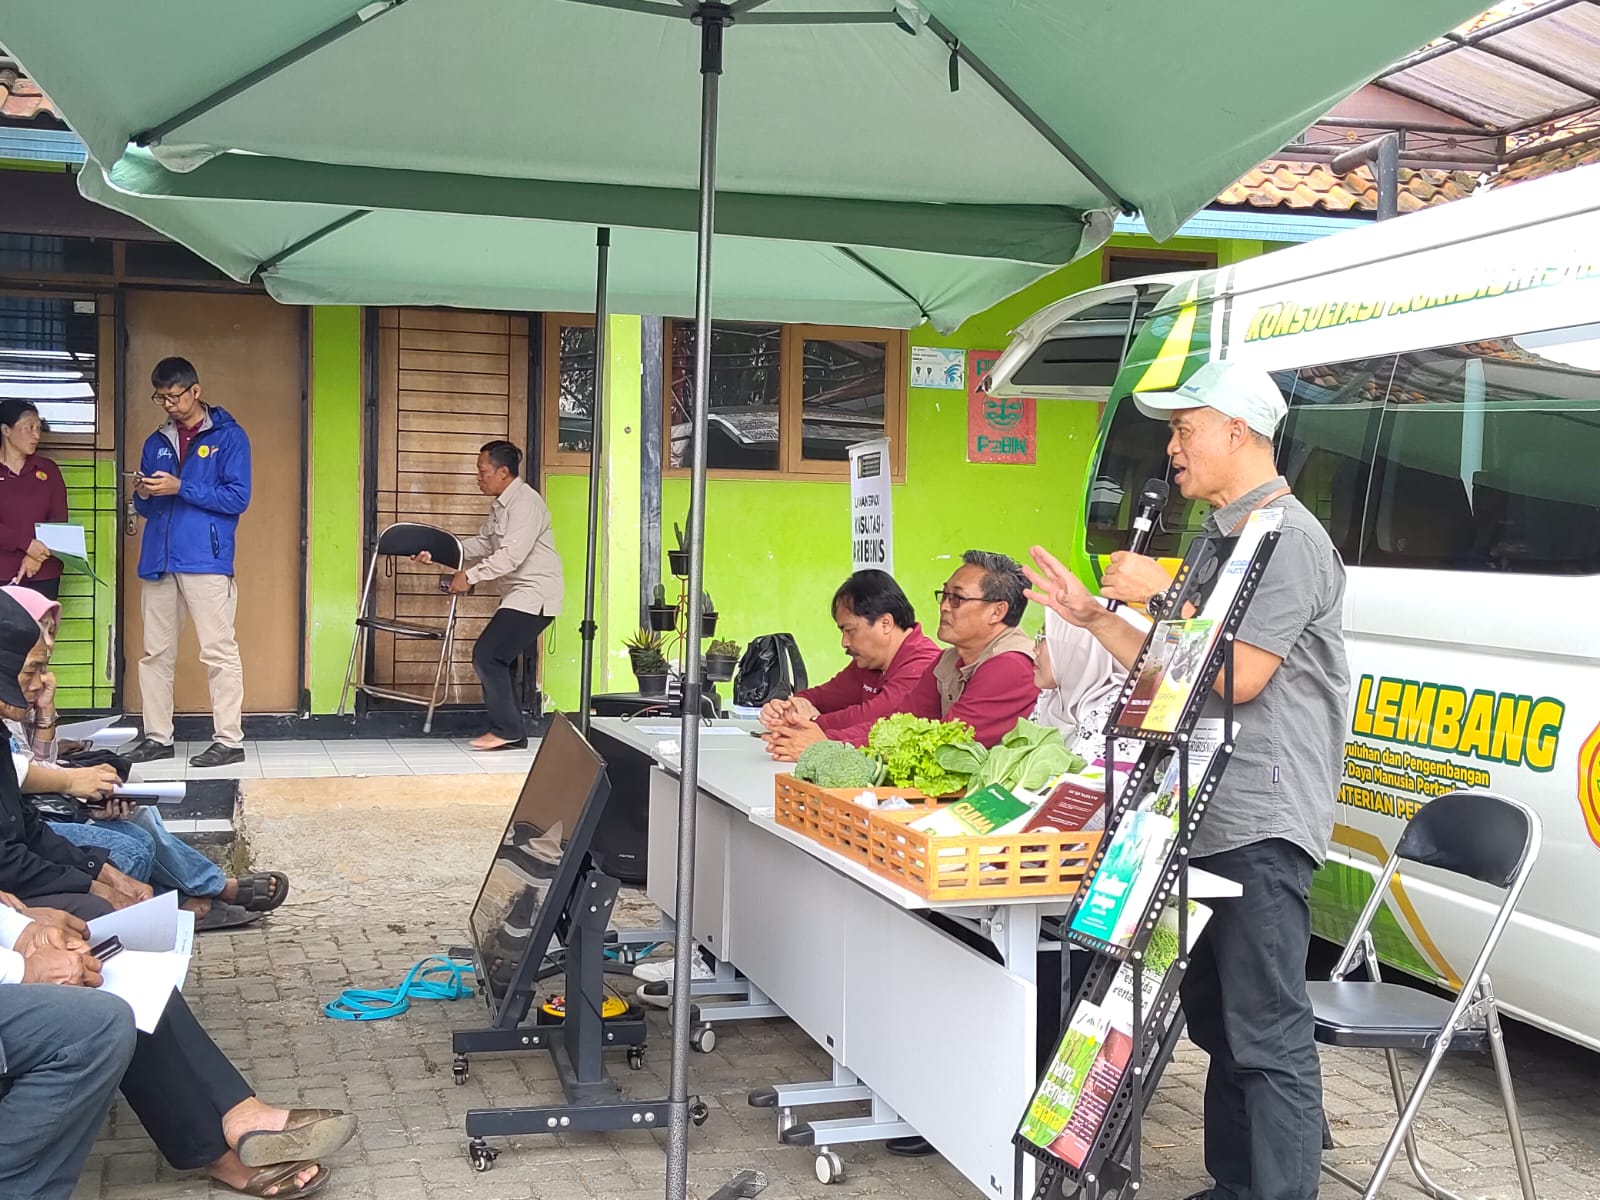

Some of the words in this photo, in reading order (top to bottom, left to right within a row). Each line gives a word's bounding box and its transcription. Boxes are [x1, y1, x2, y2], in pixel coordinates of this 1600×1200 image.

[1352, 674, 1565, 773] LEMBANG
[1344, 742, 1381, 764] yuluhan
[1382, 748, 1401, 767] dan
[1403, 752, 1490, 788] Pengembangan
[1348, 761, 1372, 783] Daya
[1373, 766, 1415, 793] Manusia
[1337, 783, 1395, 817] NTERIAN
